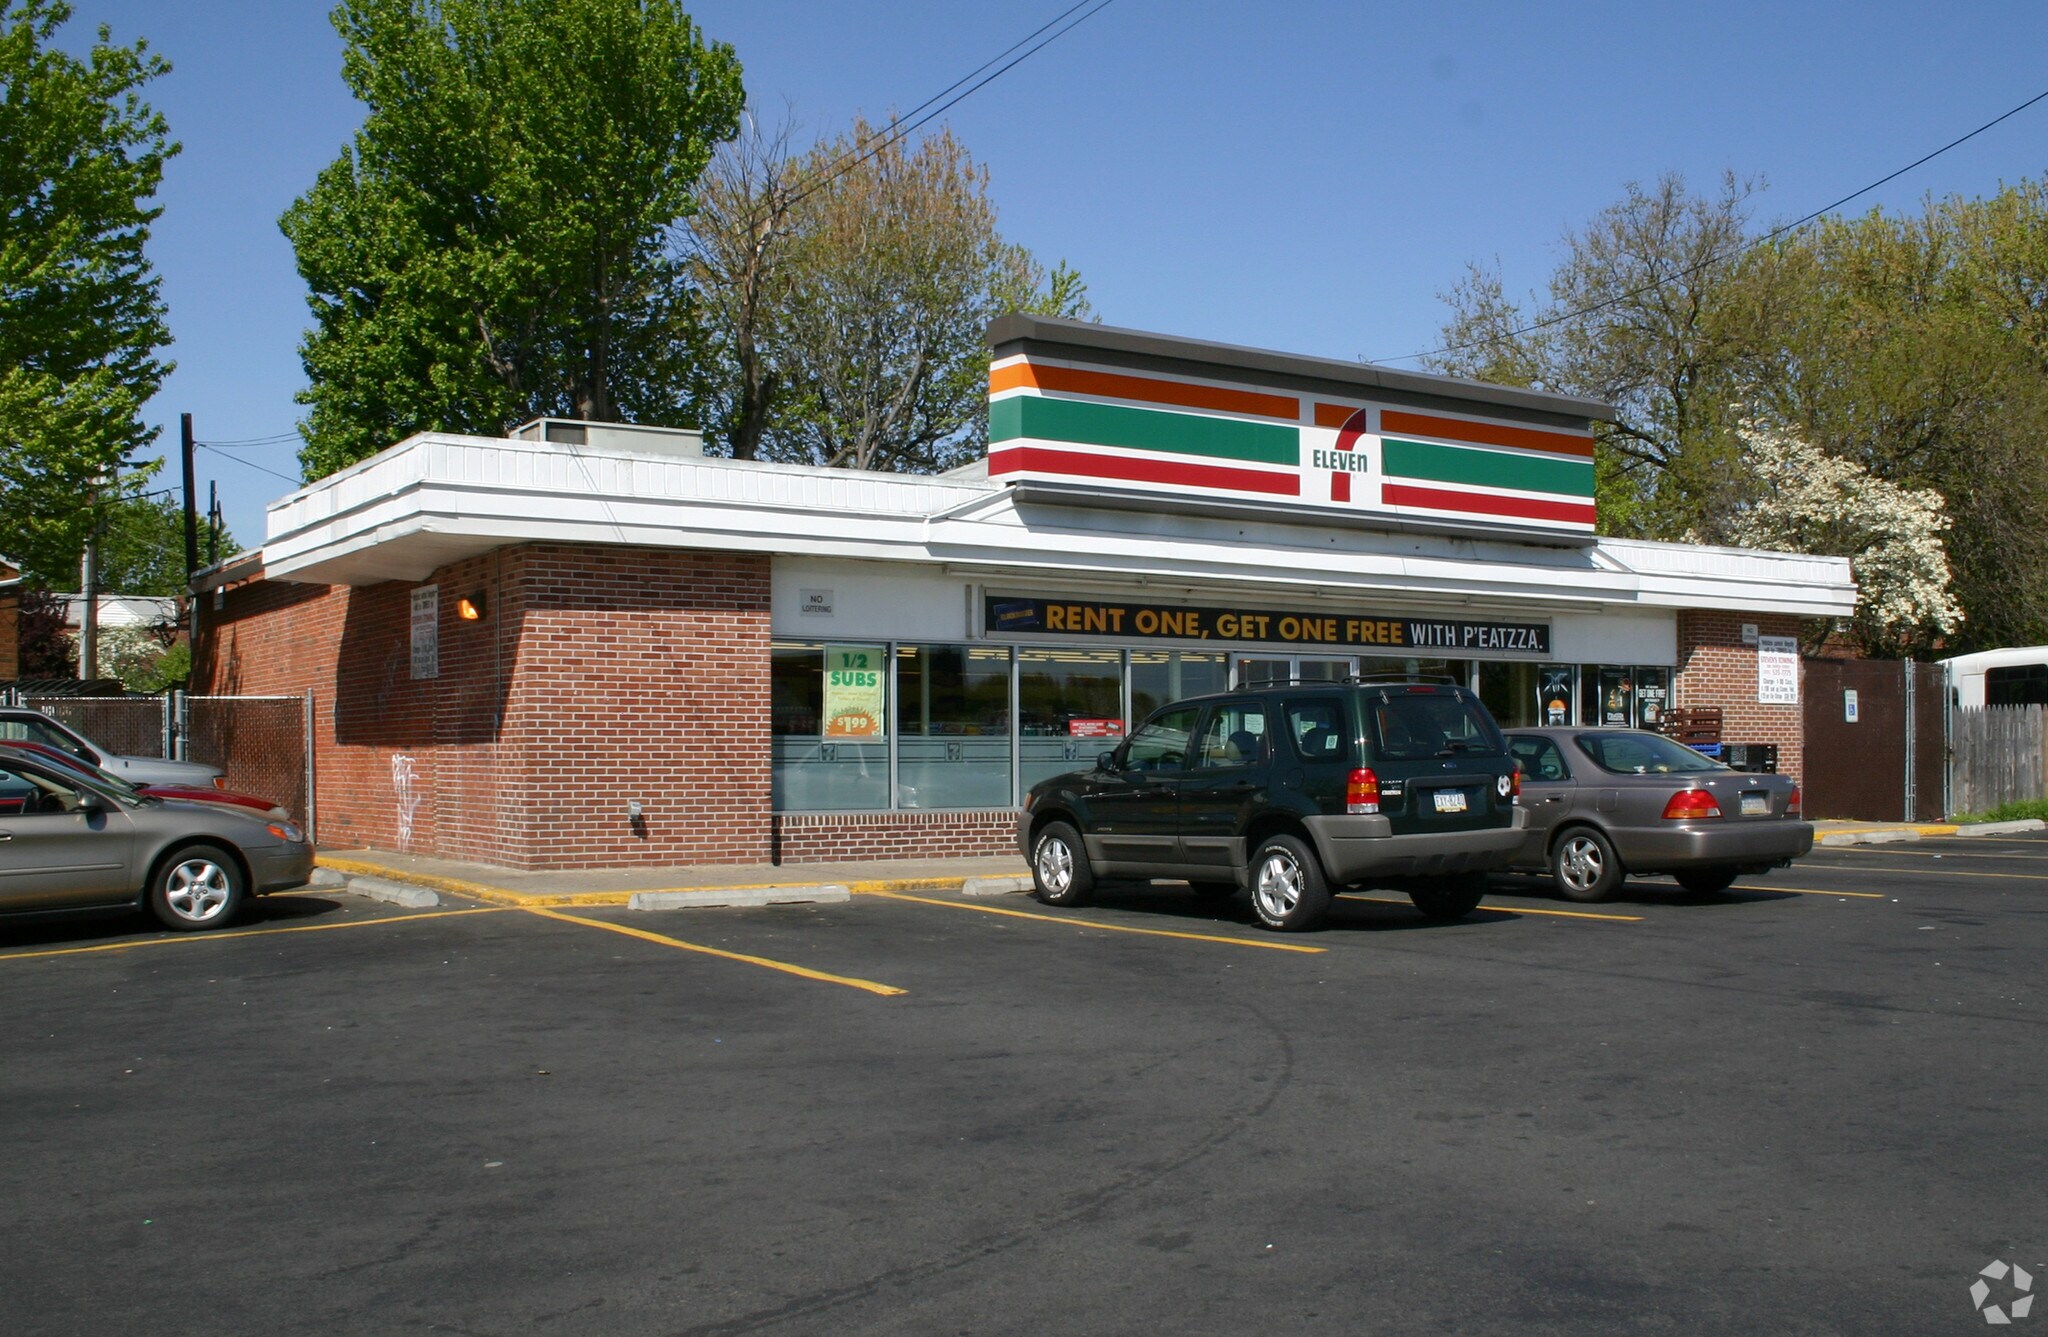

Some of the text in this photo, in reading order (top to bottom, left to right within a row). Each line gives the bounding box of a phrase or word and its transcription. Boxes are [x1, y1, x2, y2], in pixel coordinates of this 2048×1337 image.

[810, 595, 823, 604] NO
[802, 604, 832, 613] LOITERING
[1046, 605, 1125, 632] RENT
[1135, 609, 1209, 640] ONE,
[1216, 613, 1270, 639] GET
[1278, 617, 1338, 642] ONE
[1346, 620, 1403, 644] FREE
[1410, 623, 1457, 647] WITH
[842, 653, 868, 669] 1/2
[830, 671, 877, 687] SUBS
